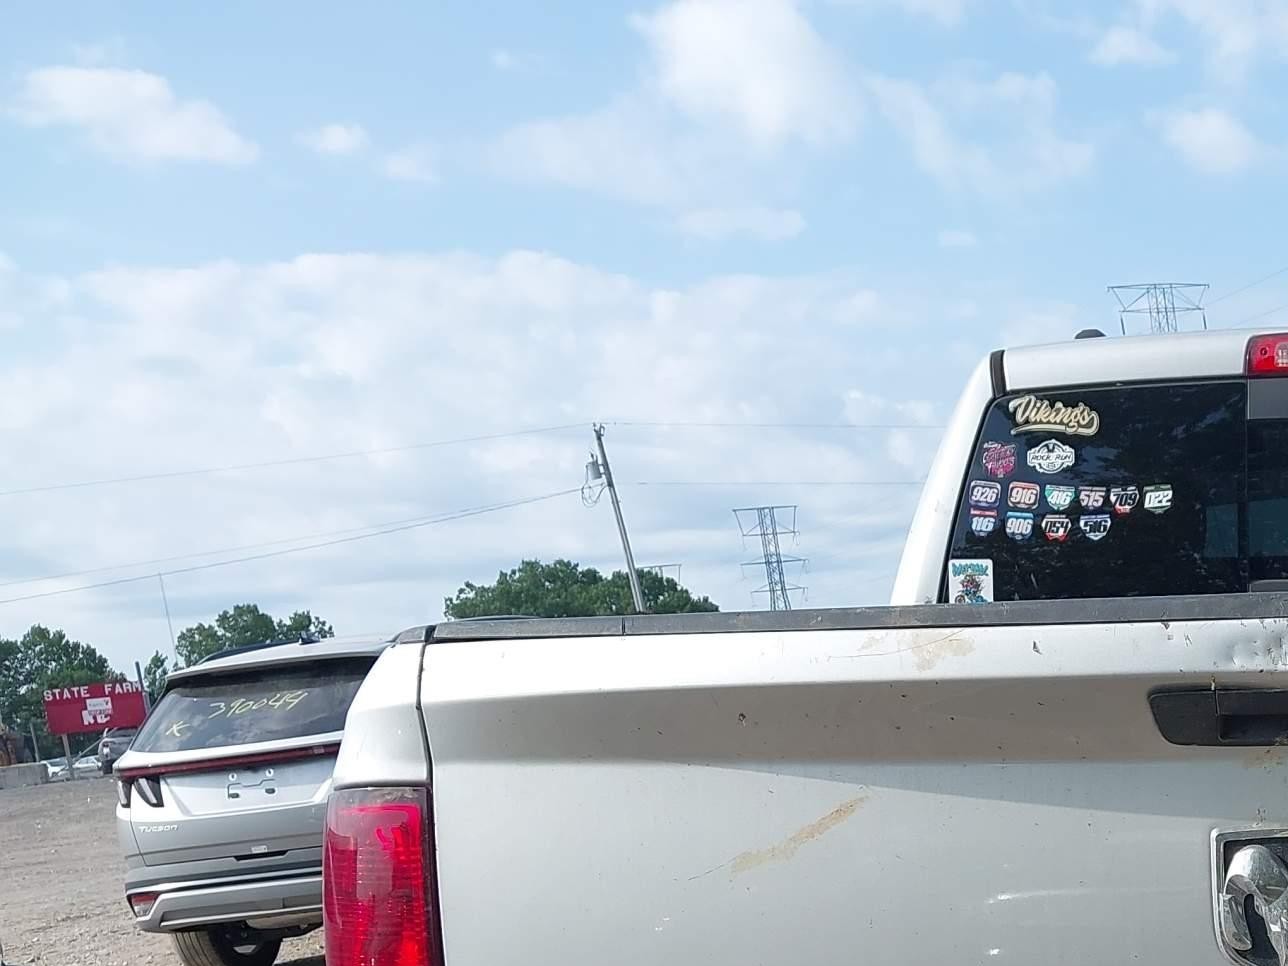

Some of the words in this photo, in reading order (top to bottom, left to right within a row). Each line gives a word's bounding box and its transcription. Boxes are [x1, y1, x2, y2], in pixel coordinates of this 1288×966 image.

[971, 486, 998, 503] 926
[1009, 487, 1037, 504] 916
[1048, 490, 1072, 505] 416
[1080, 490, 1106, 507] 515
[1112, 492, 1138, 507] 709
[971, 516, 996, 532] 116
[1006, 517, 1034, 535] 906
[1083, 519, 1109, 534] 516
[43, 685, 90, 701] STATE
[104, 681, 142, 696] FARM
